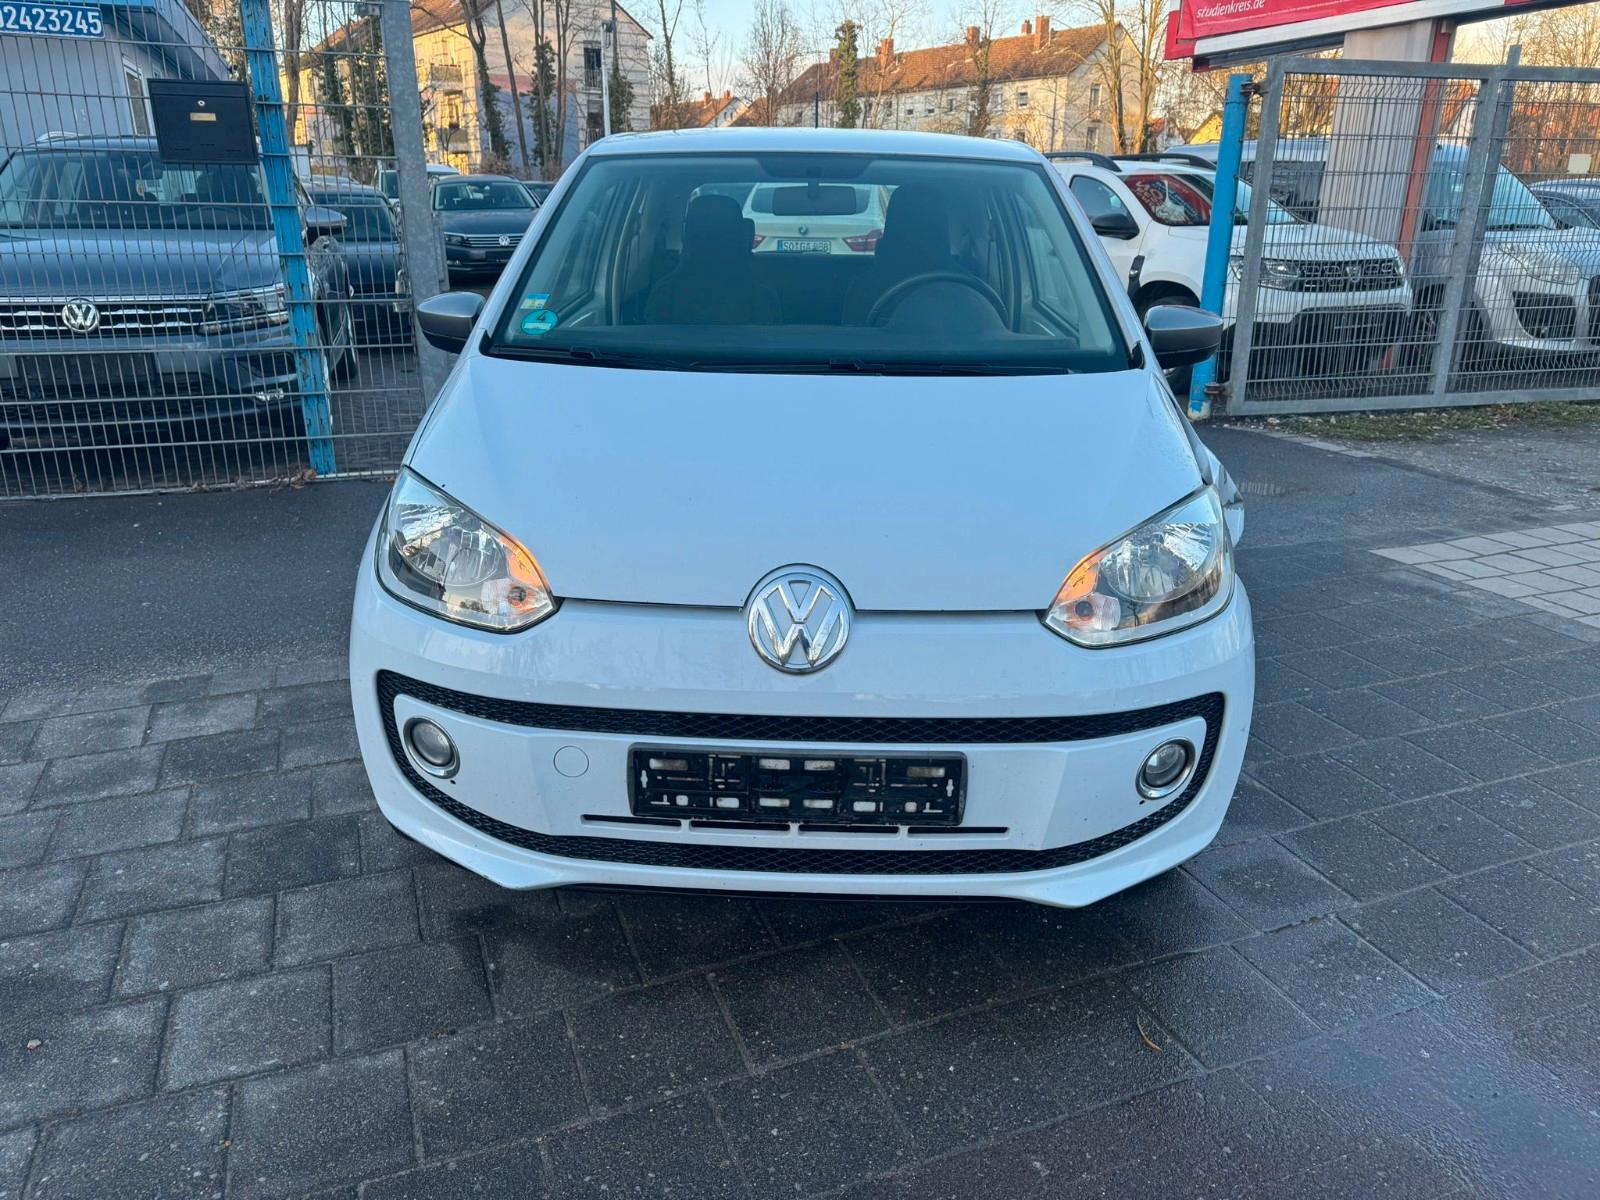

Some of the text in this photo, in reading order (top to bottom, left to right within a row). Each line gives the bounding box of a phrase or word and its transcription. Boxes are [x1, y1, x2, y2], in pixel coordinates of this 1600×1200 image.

[1196, 0, 1265, 18] studienkreis.de
[63, 300, 99, 331] VW
[752, 575, 847, 669] VW
